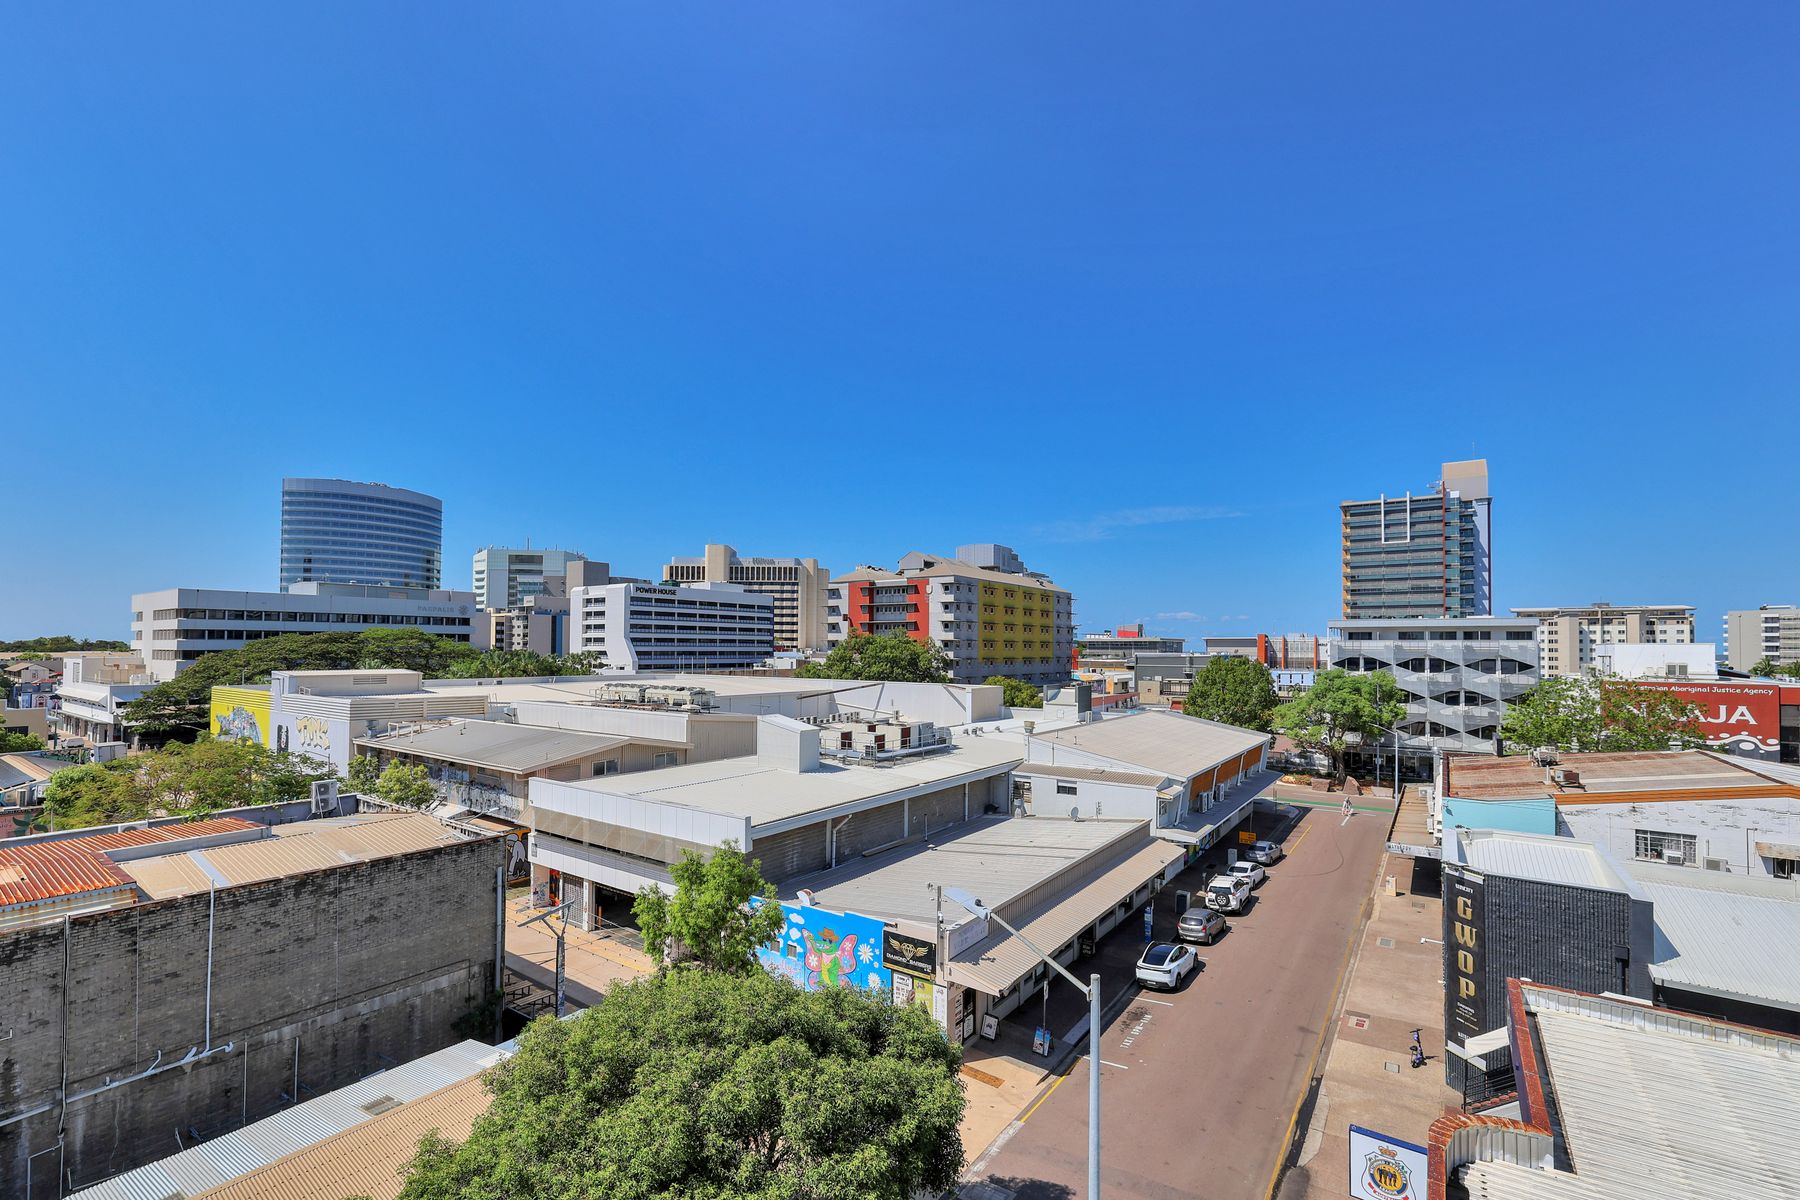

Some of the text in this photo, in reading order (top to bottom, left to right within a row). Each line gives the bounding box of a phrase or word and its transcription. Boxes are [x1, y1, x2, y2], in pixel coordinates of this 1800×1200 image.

[635, 586, 677, 596] POWER HOUSE
[1669, 685, 1710, 694] Aboriginal
[1711, 686, 1741, 694] Justice
[1743, 688, 1774, 696] Agency
[1454, 895, 1478, 1000] GWOP
